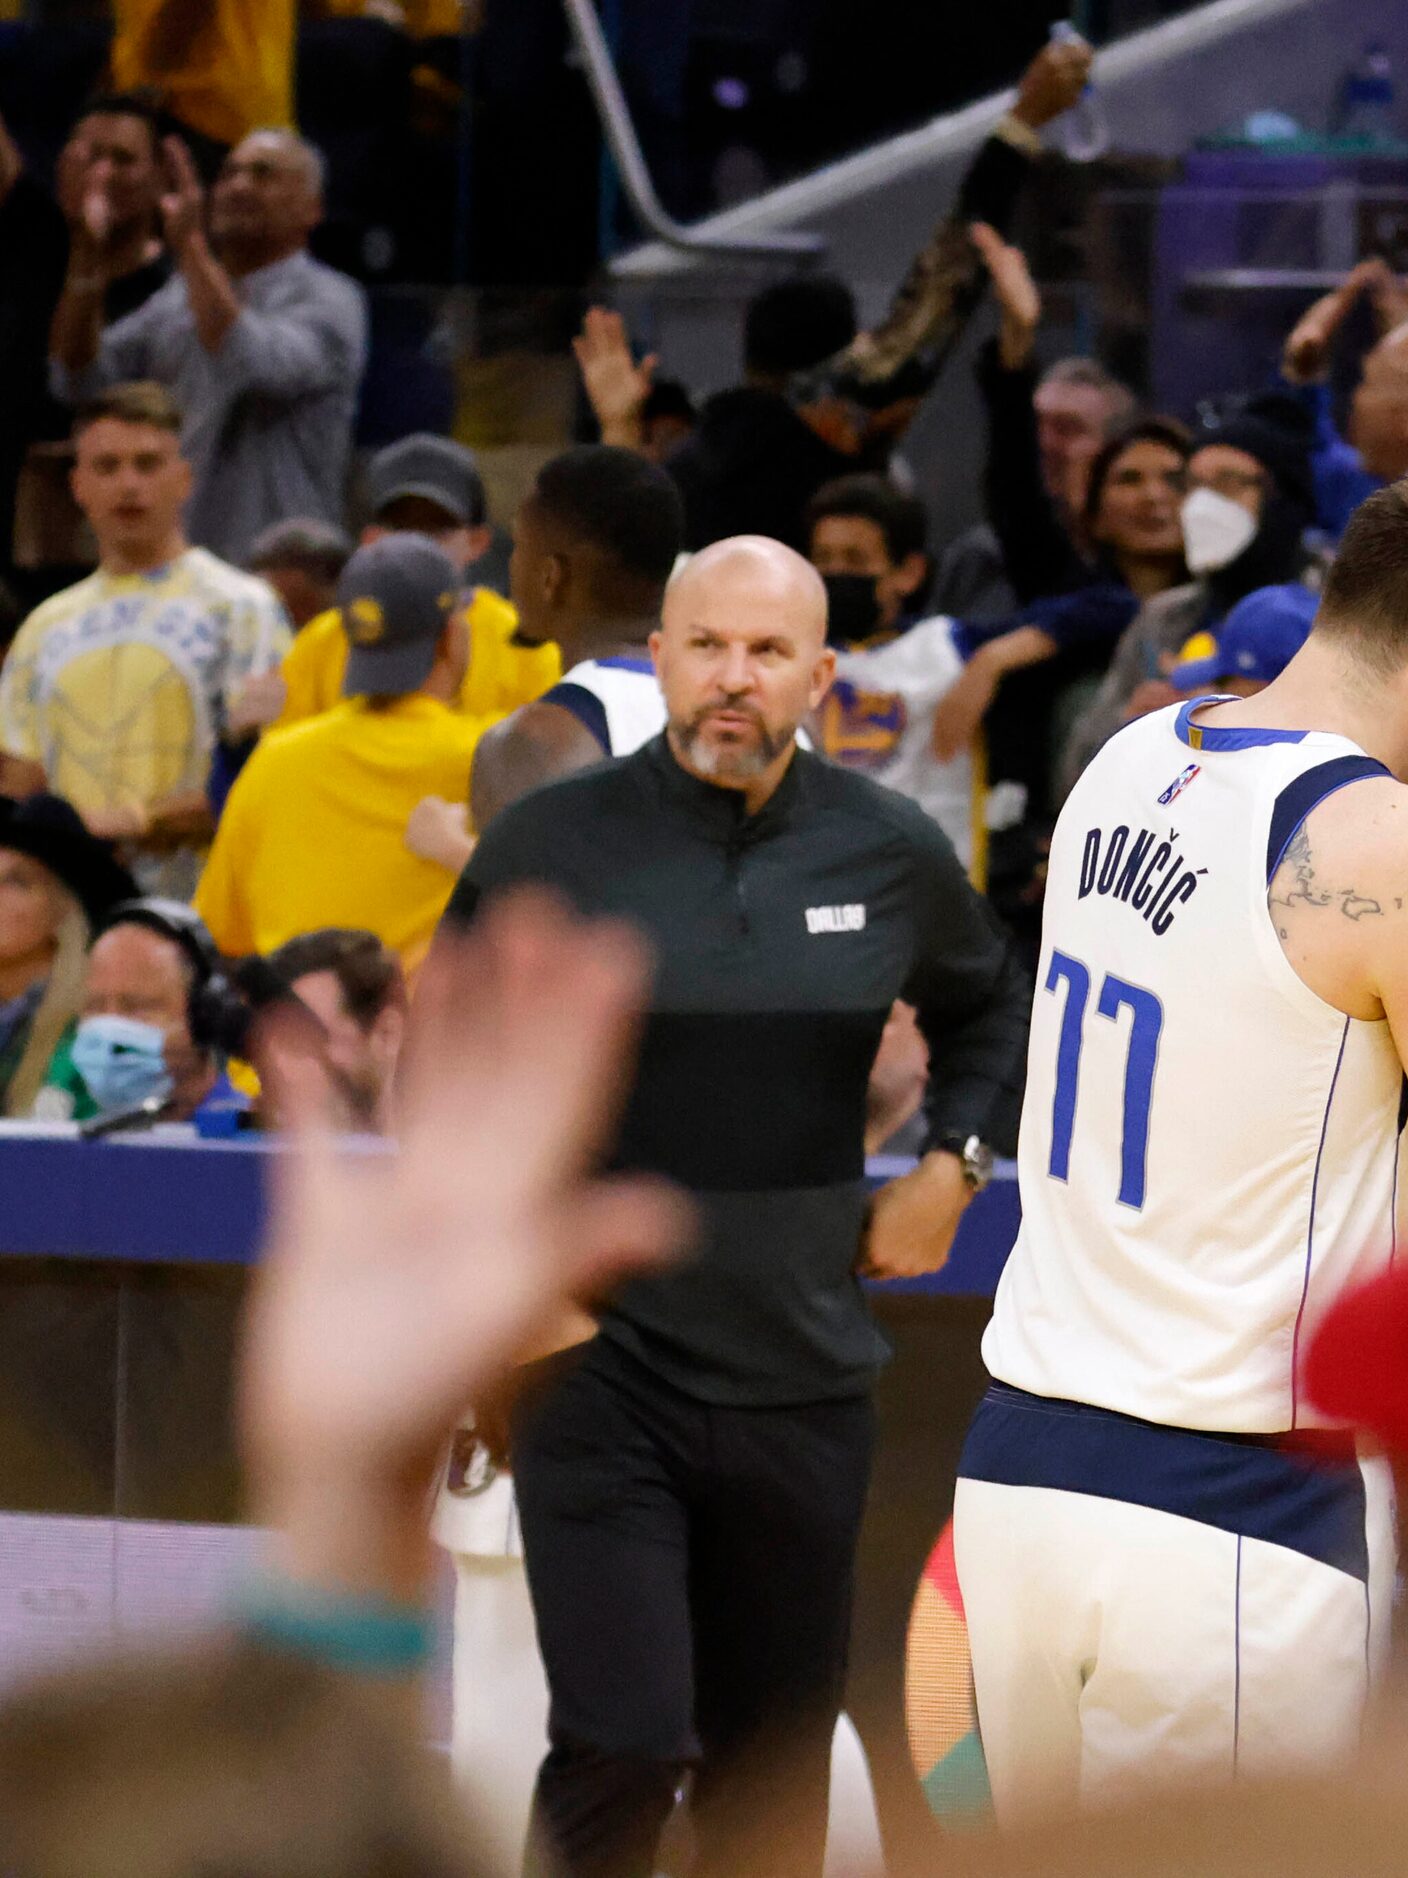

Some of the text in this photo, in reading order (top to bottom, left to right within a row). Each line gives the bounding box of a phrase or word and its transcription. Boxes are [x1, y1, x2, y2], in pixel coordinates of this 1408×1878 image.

[805, 903, 866, 934] DALLAS
[1078, 825, 1208, 936] DONČIĆ
[1044, 946, 1165, 1212] 77
